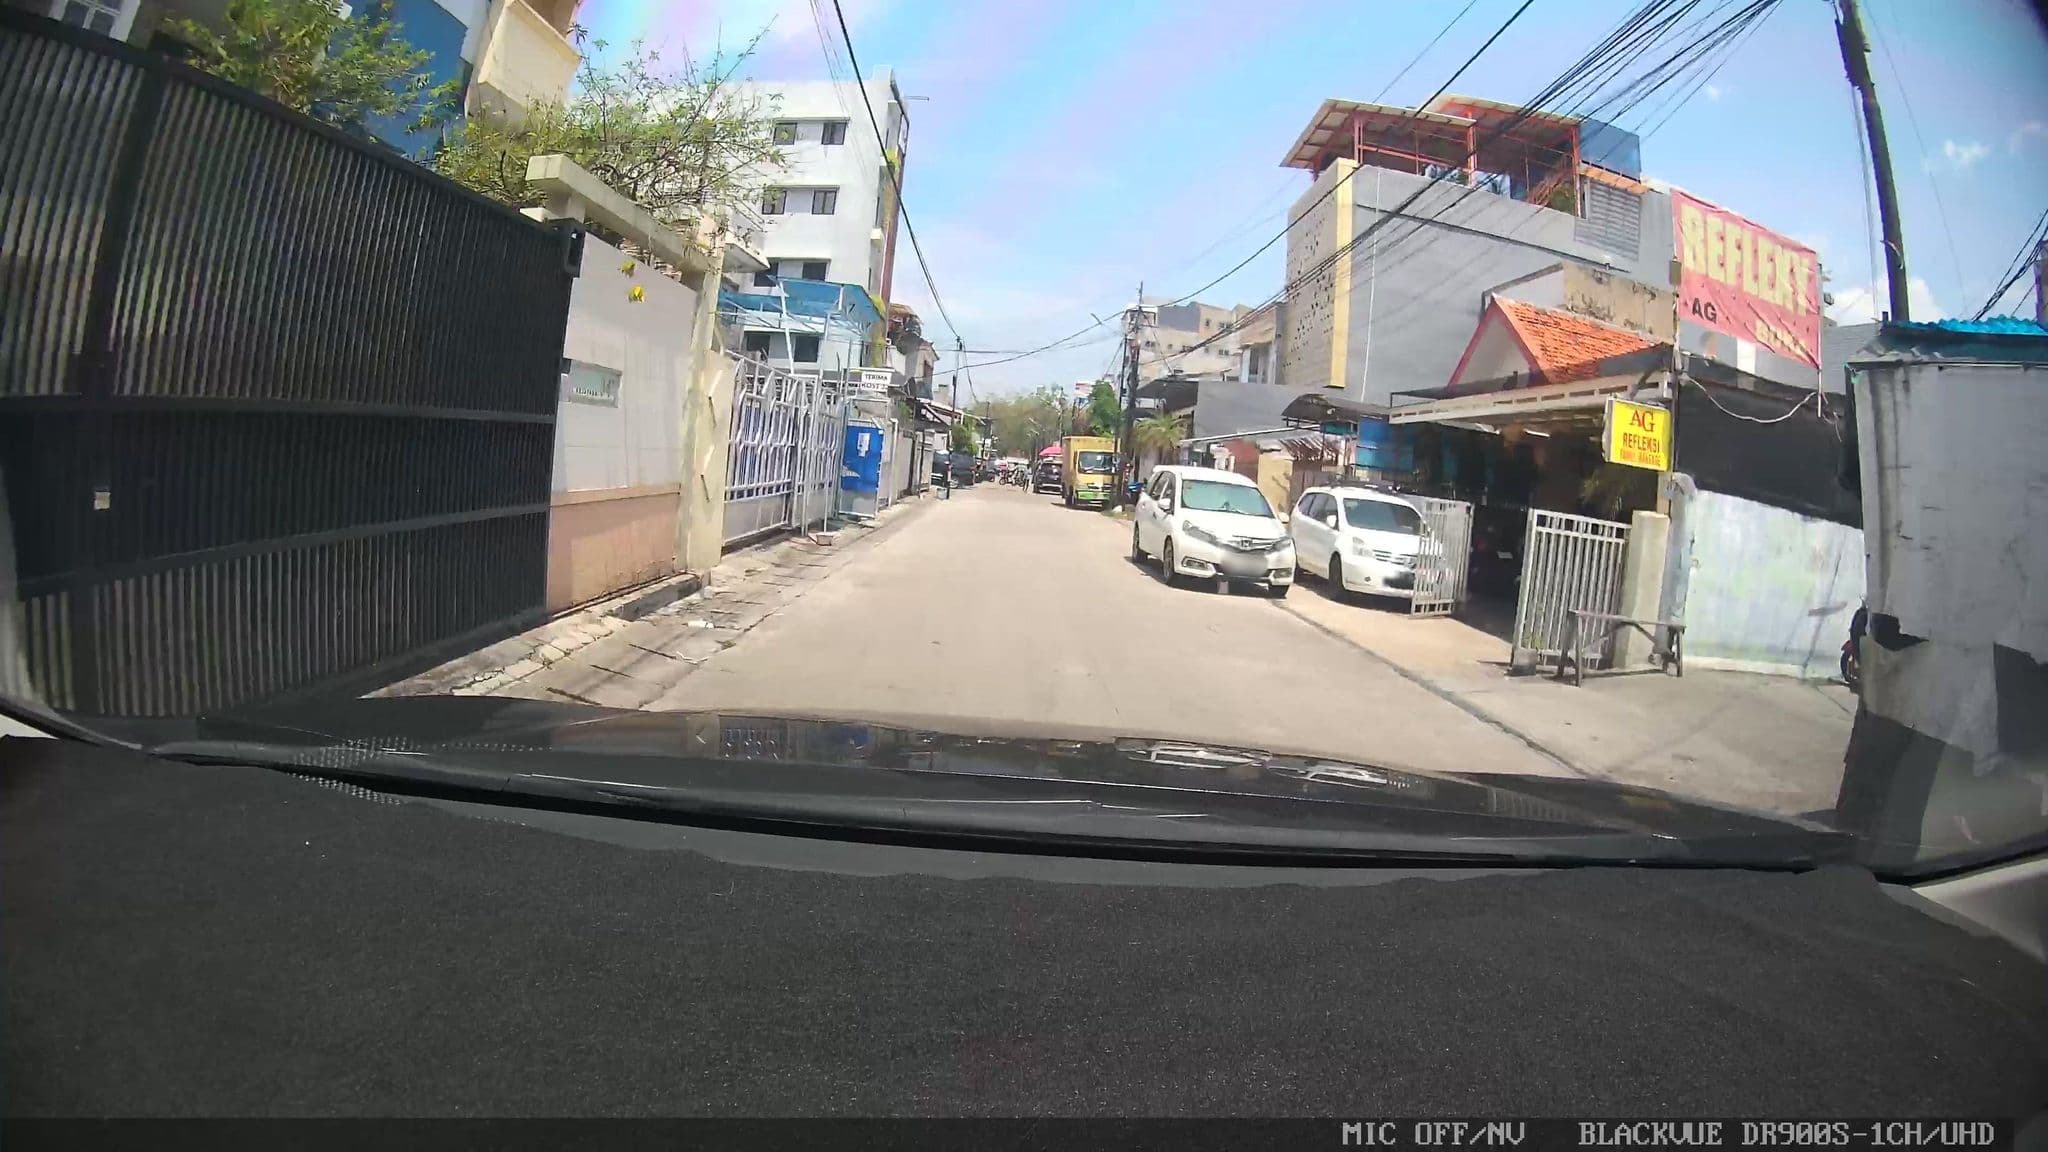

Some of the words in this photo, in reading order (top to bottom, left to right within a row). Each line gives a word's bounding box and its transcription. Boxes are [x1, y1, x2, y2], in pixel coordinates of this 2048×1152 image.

[1691, 297, 1718, 324] AG
[1629, 409, 1655, 432] AG
[1623, 432, 1660, 454] REFLEKSI
